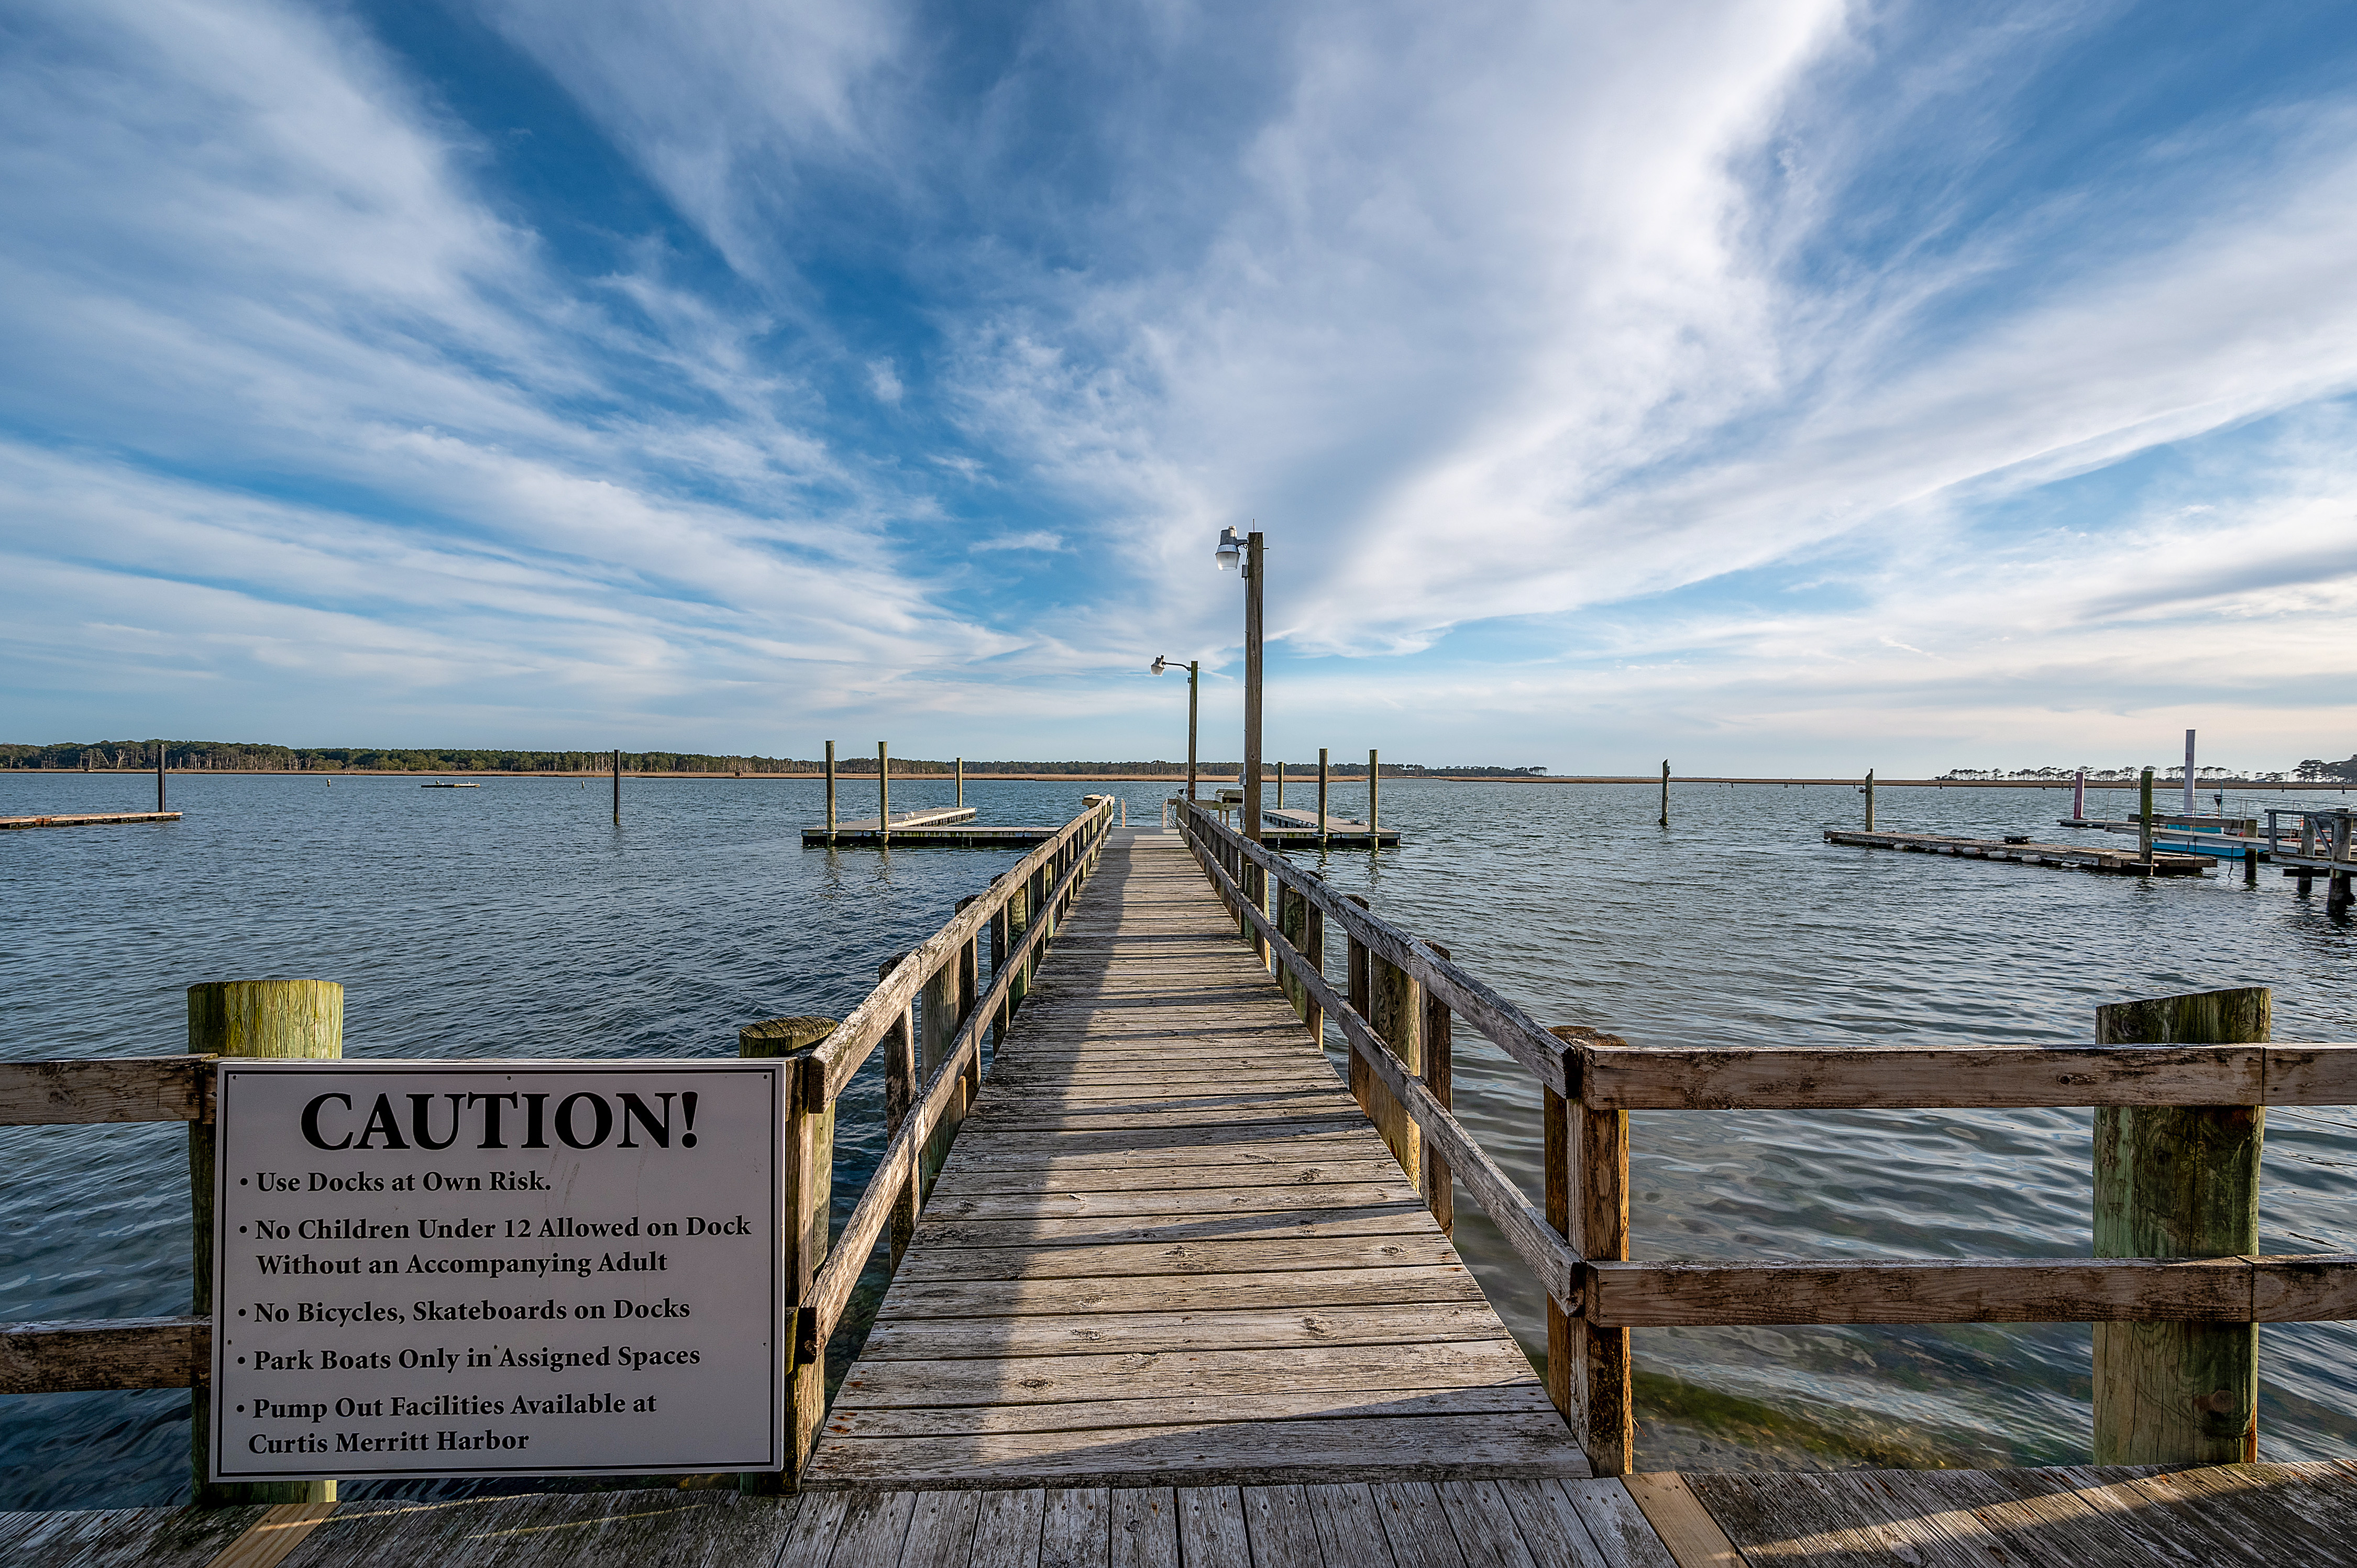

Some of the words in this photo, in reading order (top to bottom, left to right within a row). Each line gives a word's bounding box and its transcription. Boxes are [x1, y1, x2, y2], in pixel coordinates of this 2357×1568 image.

[301, 1091, 698, 1151] CAUTION!
[256, 1172, 301, 1192] Use
[307, 1171, 384, 1192] Docks
[391, 1174, 416, 1191] at
[423, 1172, 482, 1191] Own
[489, 1170, 551, 1191] Risk.
[255, 1220, 290, 1240] No
[298, 1218, 411, 1240] Children
[417, 1218, 496, 1239] Under
[504, 1219, 532, 1238] 12
[537, 1216, 640, 1238] Allowed
[647, 1222, 679, 1236] on
[686, 1214, 752, 1236] Dock
[255, 1253, 362, 1275] Without
[368, 1260, 400, 1274] an
[405, 1252, 592, 1278] Accompanying
[597, 1251, 668, 1272] Adult
[254, 1302, 290, 1322] No
[296, 1301, 405, 1328] Bicycles,
[413, 1299, 567, 1321] Skateboards
[574, 1305, 607, 1319] on
[613, 1297, 690, 1319] Docks
[253, 1349, 314, 1371] Park
[320, 1350, 391, 1370] Boats
[399, 1347, 461, 1374] Only
[467, 1348, 493, 1367] in
[498, 1345, 611, 1373] Assigned
[618, 1346, 700, 1371] Spaces
[252, 1399, 328, 1423] Pump
[335, 1397, 383, 1418] Out
[389, 1395, 504, 1416] Facilities
[510, 1393, 626, 1415] Available
[633, 1395, 657, 1412] at
[248, 1432, 328, 1454] Curtis
[335, 1431, 429, 1452] Merritt
[436, 1429, 530, 1451] Harbor
